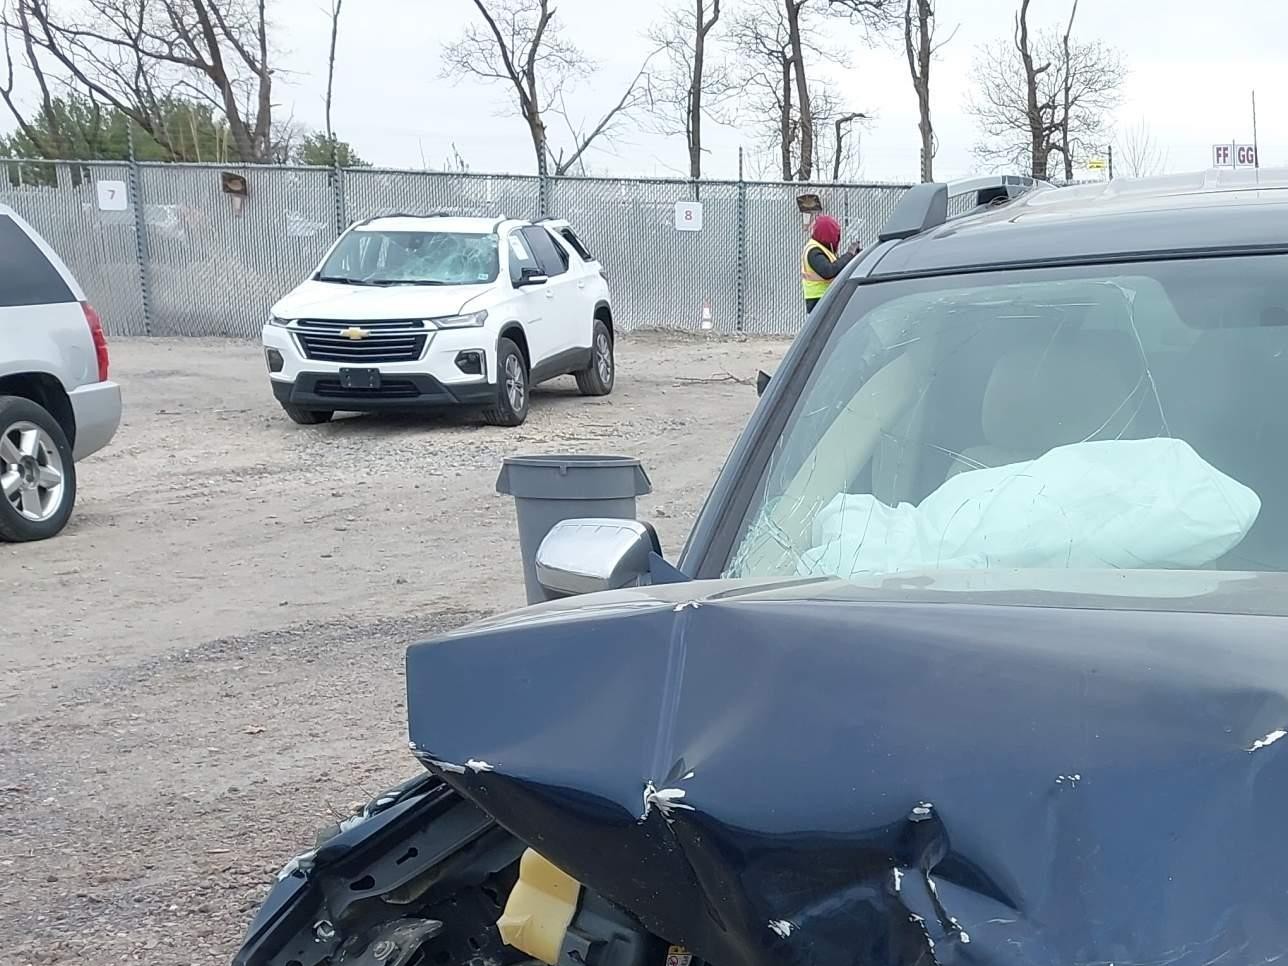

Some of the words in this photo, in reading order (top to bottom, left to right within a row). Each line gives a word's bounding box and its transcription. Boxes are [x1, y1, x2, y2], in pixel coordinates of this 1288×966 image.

[1216, 146, 1229, 164] FF
[1238, 146, 1254, 164] GG
[107, 189, 116, 200] 7
[684, 210, 693, 221] 8
